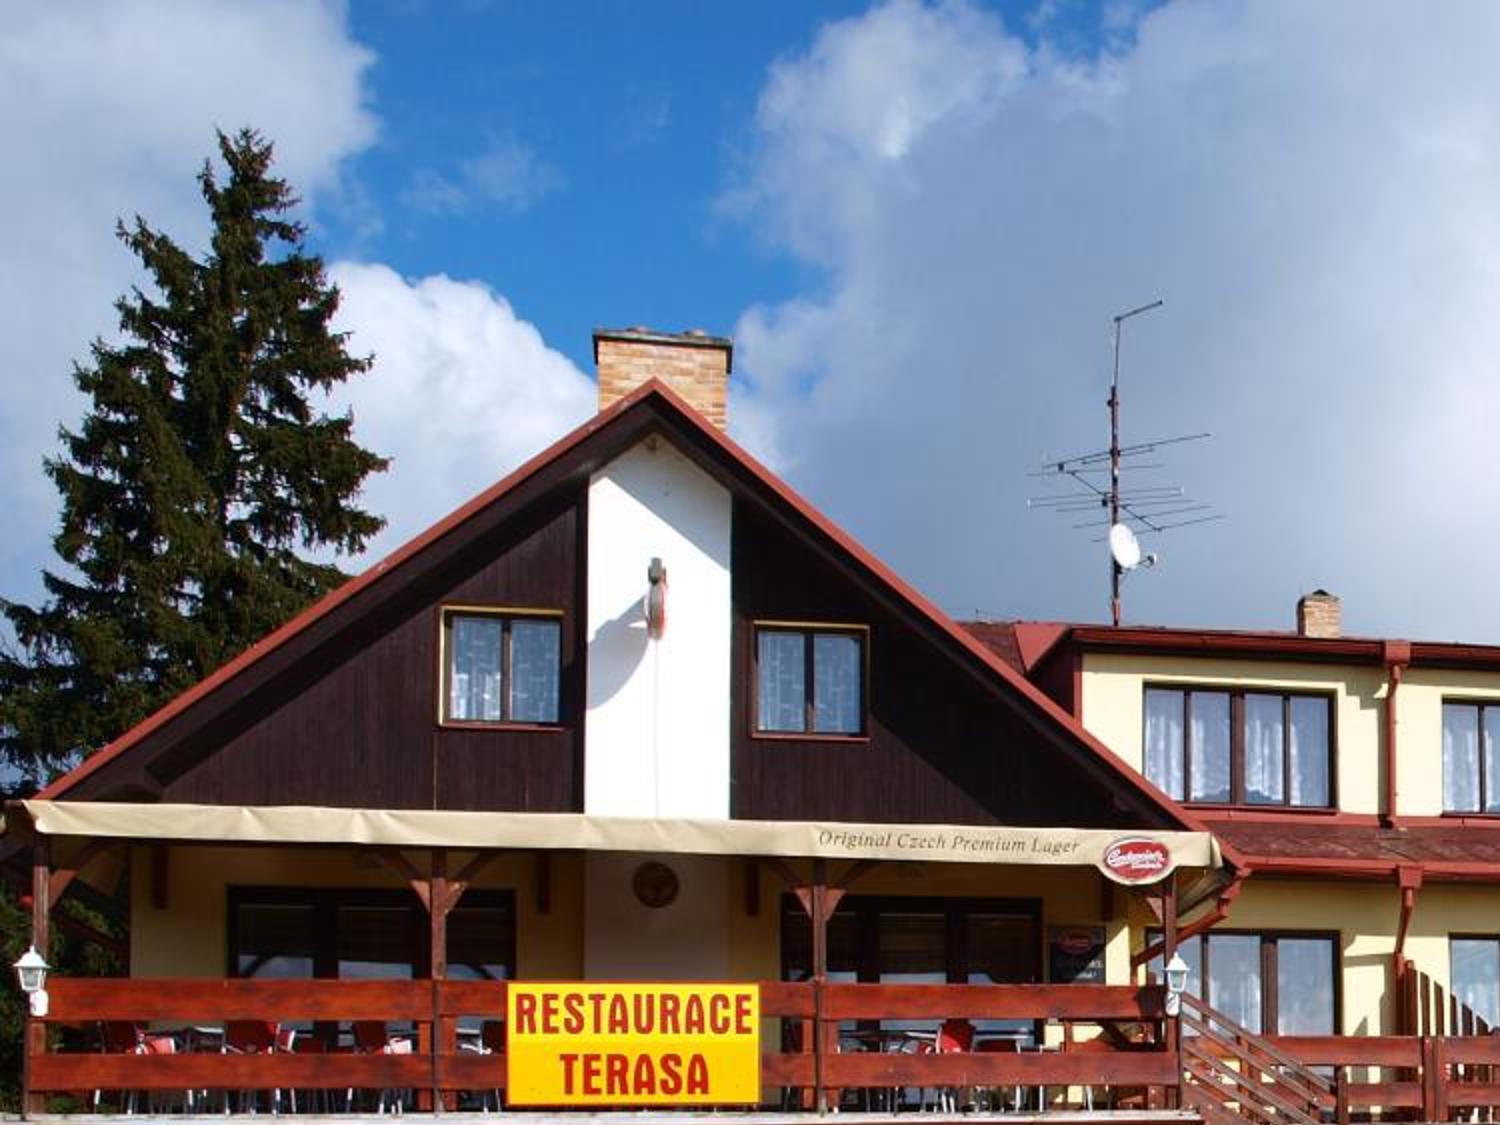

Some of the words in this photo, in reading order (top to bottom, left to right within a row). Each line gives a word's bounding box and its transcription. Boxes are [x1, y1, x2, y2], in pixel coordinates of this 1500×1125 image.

[818, 831, 891, 849] Original
[896, 833, 946, 849] Czech
[950, 834, 1026, 852] Premium
[1030, 836, 1081, 854] Lager
[515, 993, 753, 1035] RESTAURACE
[559, 1053, 710, 1096] TERASA
